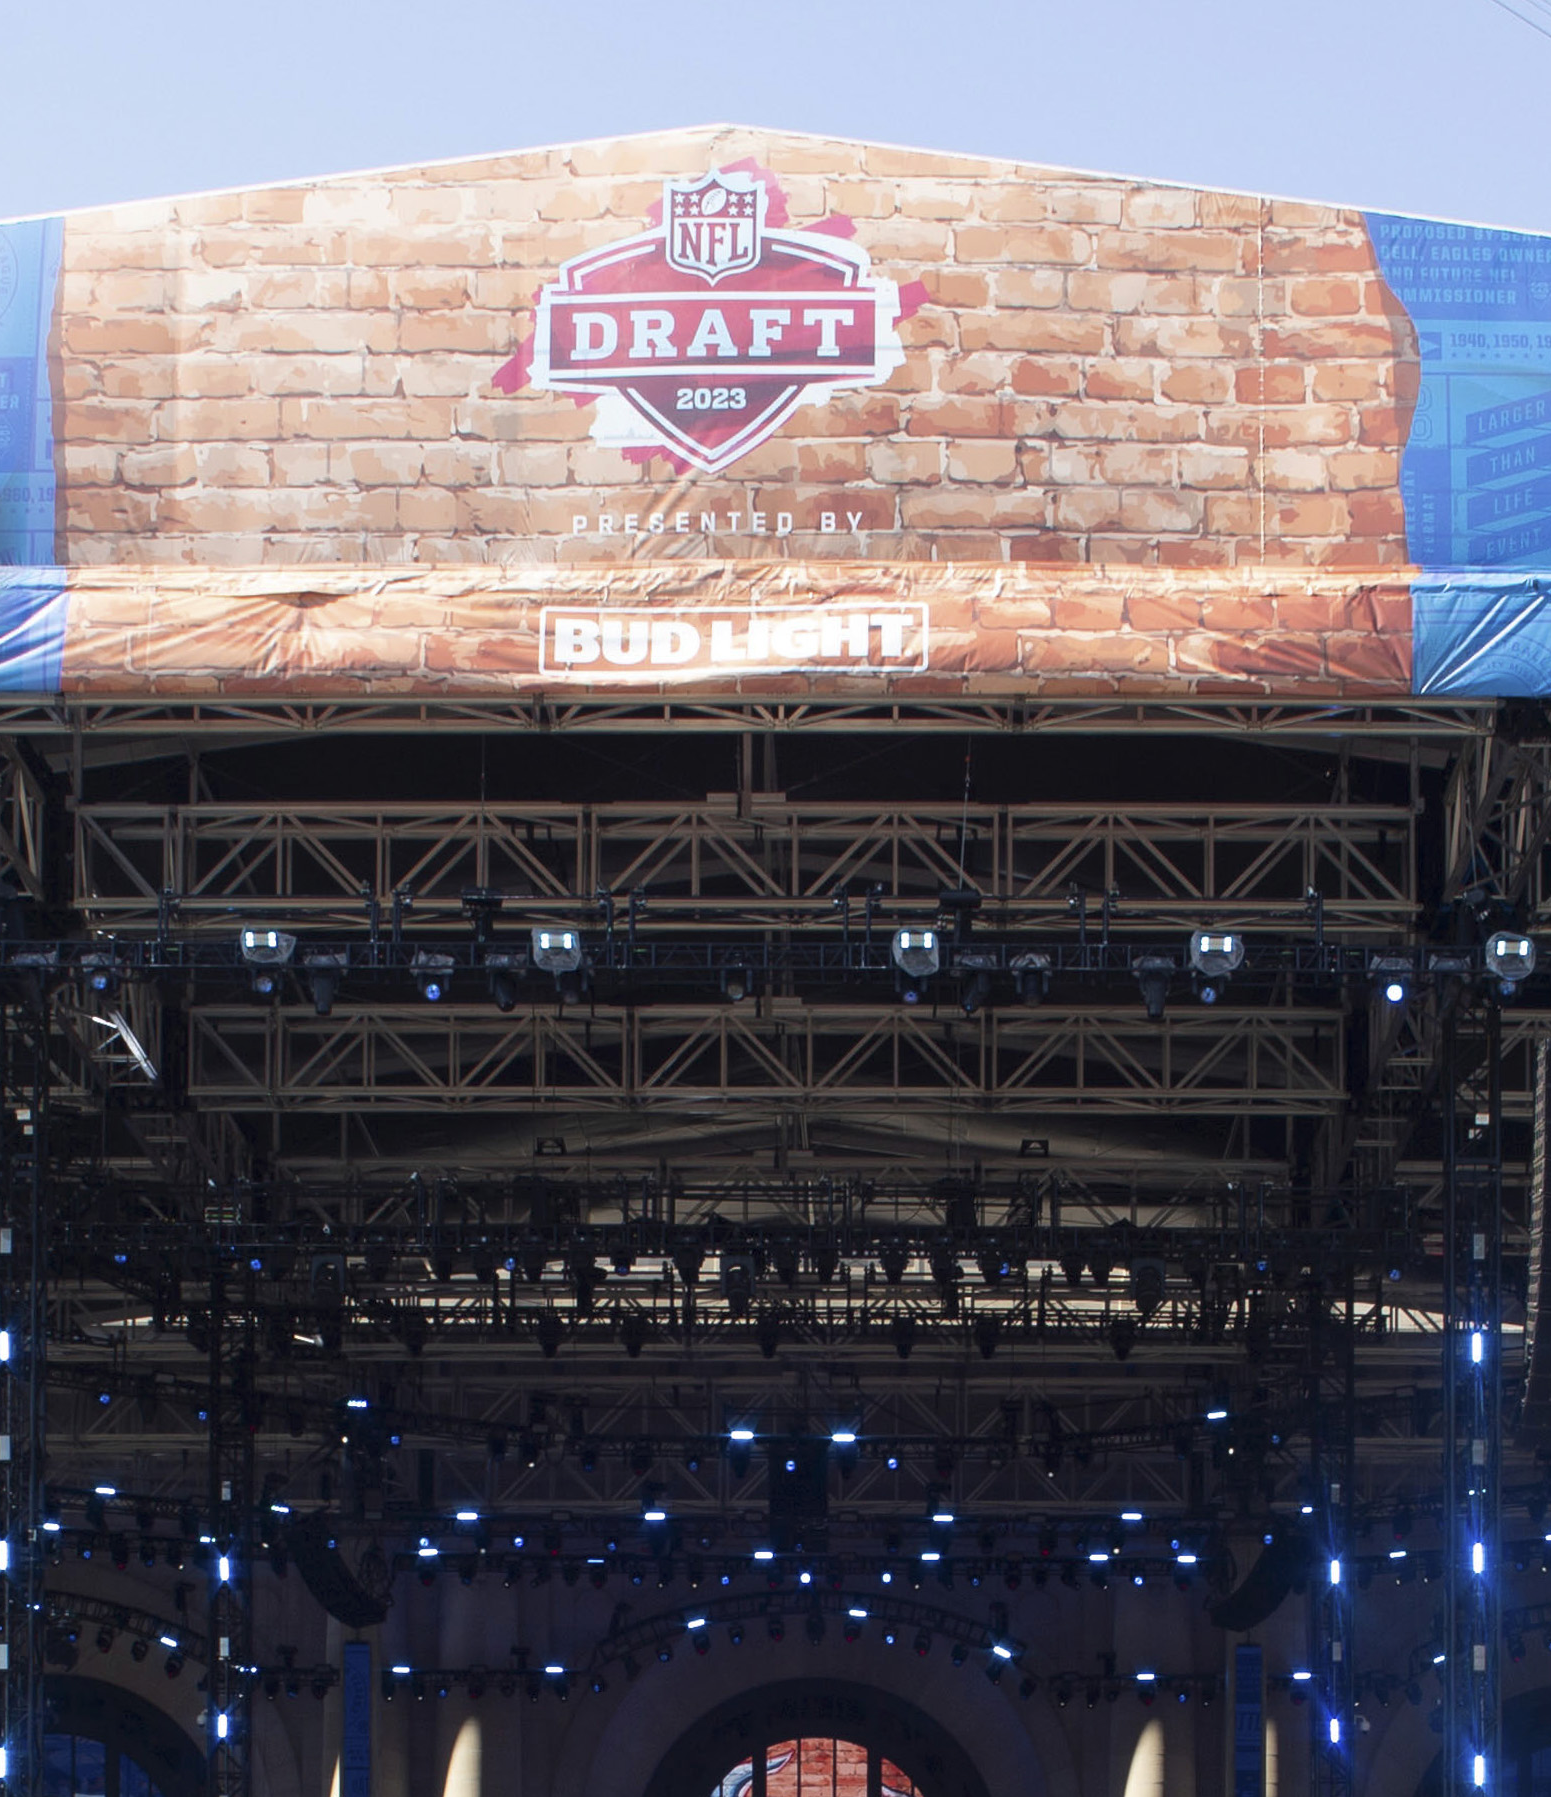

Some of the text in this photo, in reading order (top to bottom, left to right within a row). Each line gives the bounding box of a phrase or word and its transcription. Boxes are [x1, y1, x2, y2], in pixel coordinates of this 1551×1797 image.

[677, 222, 749, 264] NFL
[1380, 224, 1466, 239] PROPOSED
[1431, 247, 1492, 262] EAGLES
[1421, 268, 1483, 282] FUTURE
[1394, 288, 1517, 304] OMMISSIONER
[570, 309, 854, 361] DRAFT
[676, 387, 747, 411] 2023
[1478, 401, 1545, 433] LARGER
[1490, 446, 1535, 473] THAN
[1495, 488, 1532, 514] LIFE
[574, 512, 864, 536] PRESENTED BY
[1485, 528, 1541, 560] EVENT
[555, 614, 913, 664] BUD LIGHT
